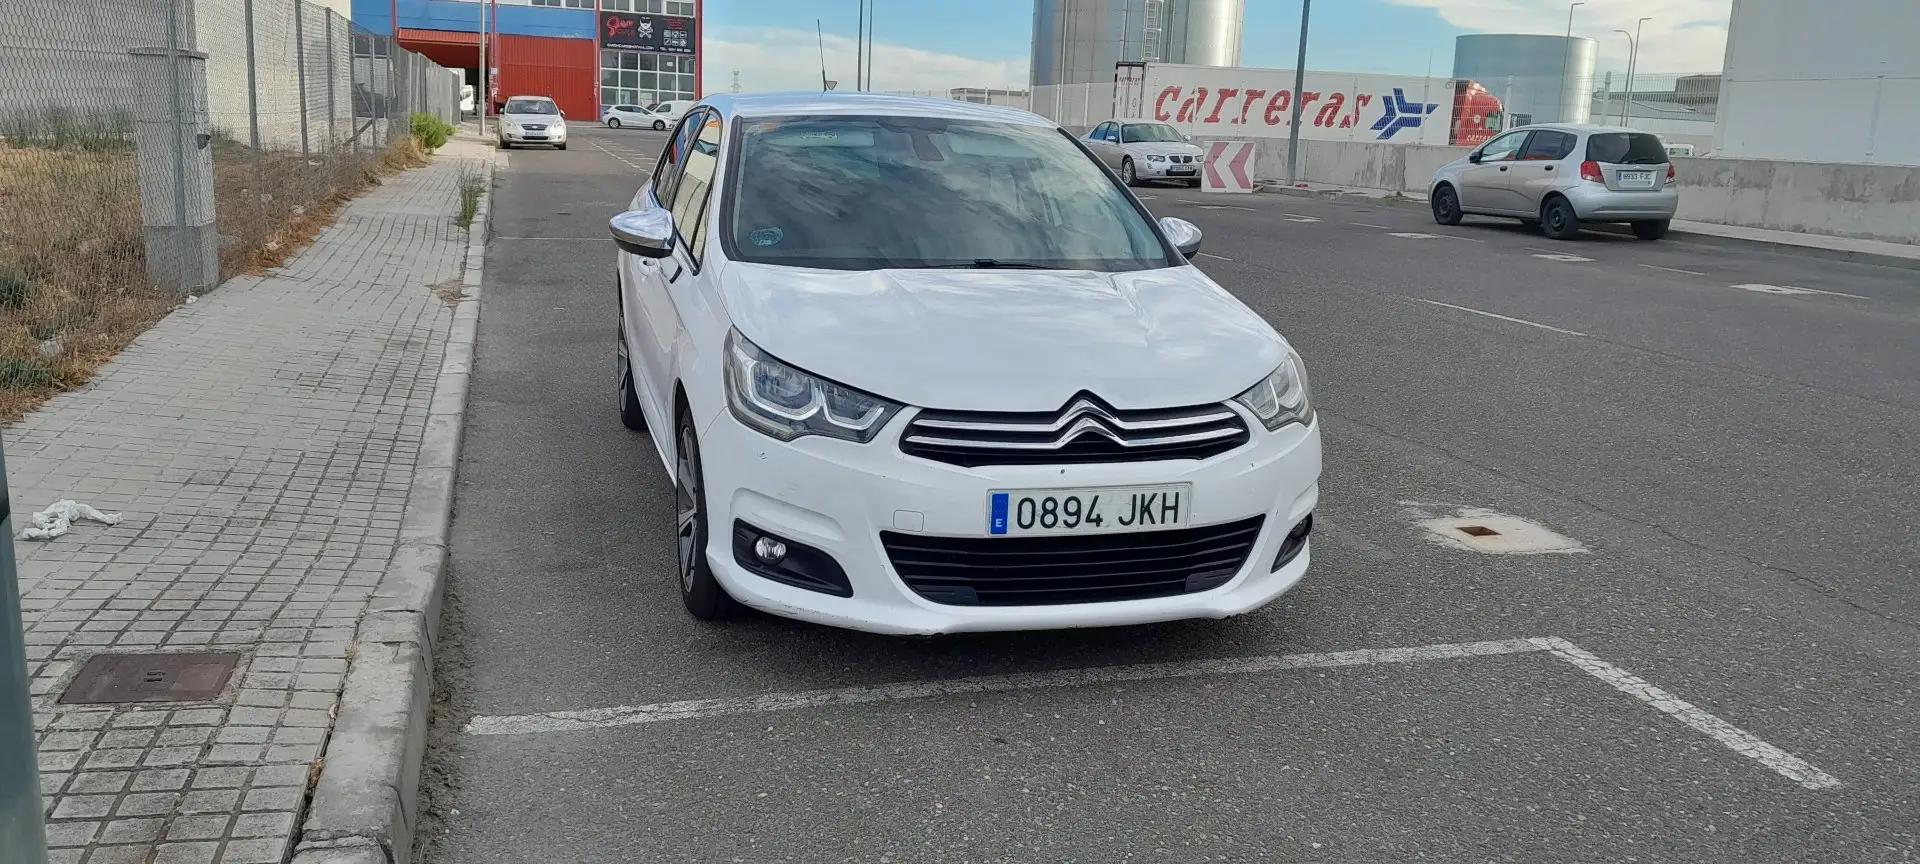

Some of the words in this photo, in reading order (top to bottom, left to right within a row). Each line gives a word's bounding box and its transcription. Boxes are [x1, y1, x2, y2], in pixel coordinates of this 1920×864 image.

[1154, 85, 1373, 129] carreras
[995, 518, 1003, 528] E
[1016, 495, 1103, 530] 0894
[1118, 492, 1180, 526] JKH
